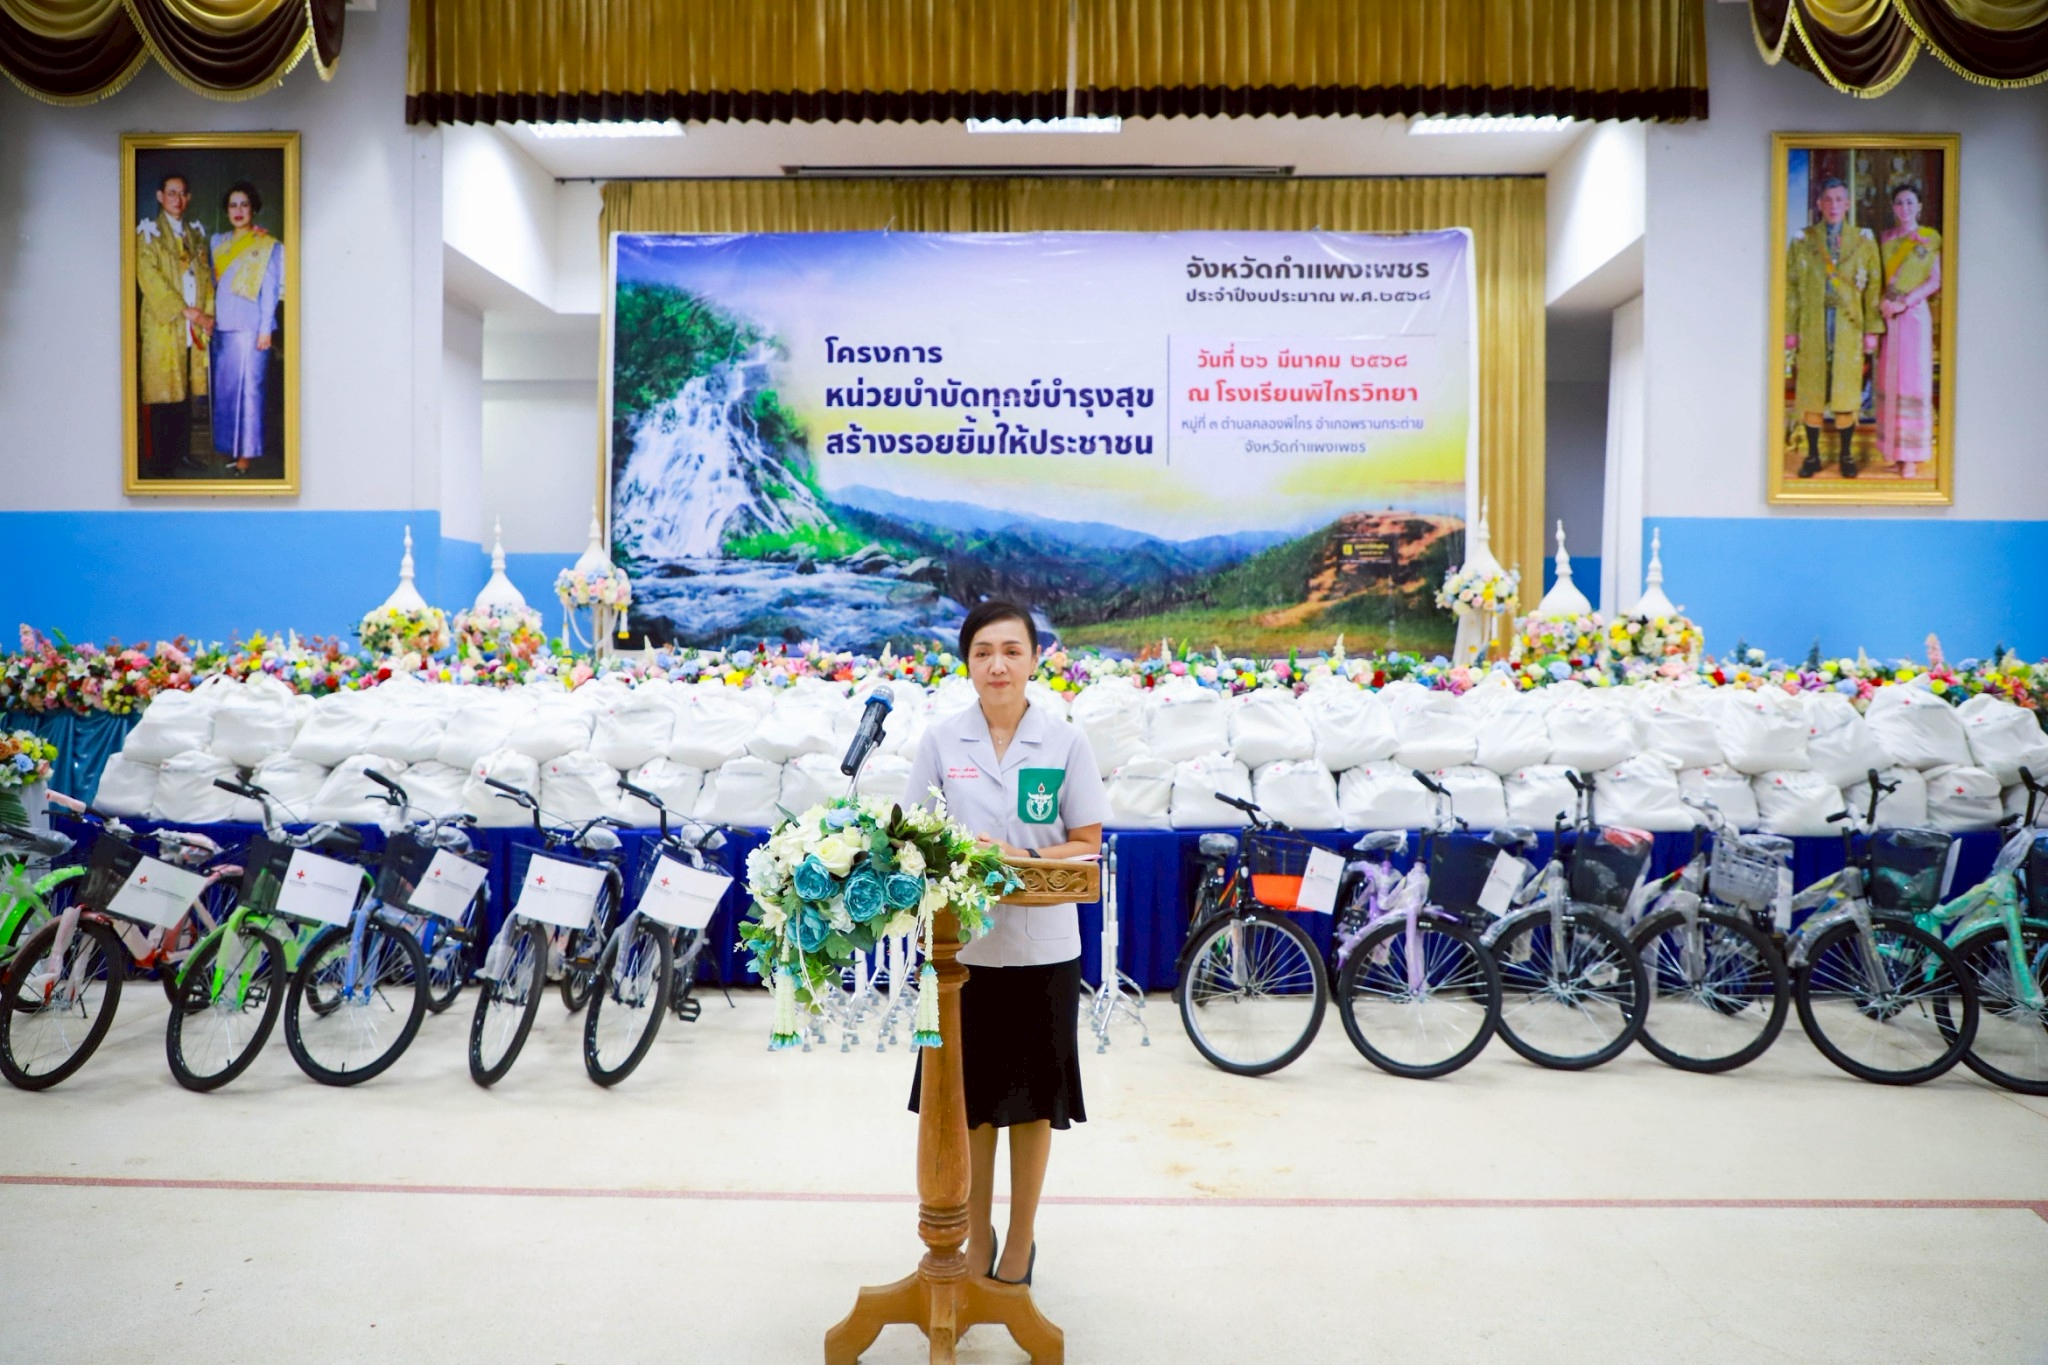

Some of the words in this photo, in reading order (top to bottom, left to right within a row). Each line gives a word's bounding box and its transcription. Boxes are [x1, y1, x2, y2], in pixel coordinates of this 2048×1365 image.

[1186, 254, 1430, 280] จังหวัดกำแพงเพชร
[1186, 286, 1335, 303] ประจำปีงบประมาณ
[1339, 288, 1431, 303] พ.ศ.๒๕๖๘
[824, 336, 943, 364] โครงการ
[1197, 342, 1235, 368] วันที่
[1240, 354, 1269, 368] ๒๖
[1277, 348, 1341, 368] มีนาคม
[1350, 353, 1408, 368] ๒๕๖๘
[825, 377, 1154, 418] หน่วยบำบัดทุกข์บำรุงสุข
[1188, 387, 1210, 402] ณ
[1215, 379, 1419, 402] โรงเรียนพิไกรวิทยา
[826, 415, 1153, 455] สร้างรอยยิ้มให้ประชาชน
[1181, 414, 1206, 434] หมู่ที่
[1220, 415, 1313, 430] ตำบลคลองพิไกร
[1245, 439, 1366, 454] จังหวัดกำแพงเพชร
